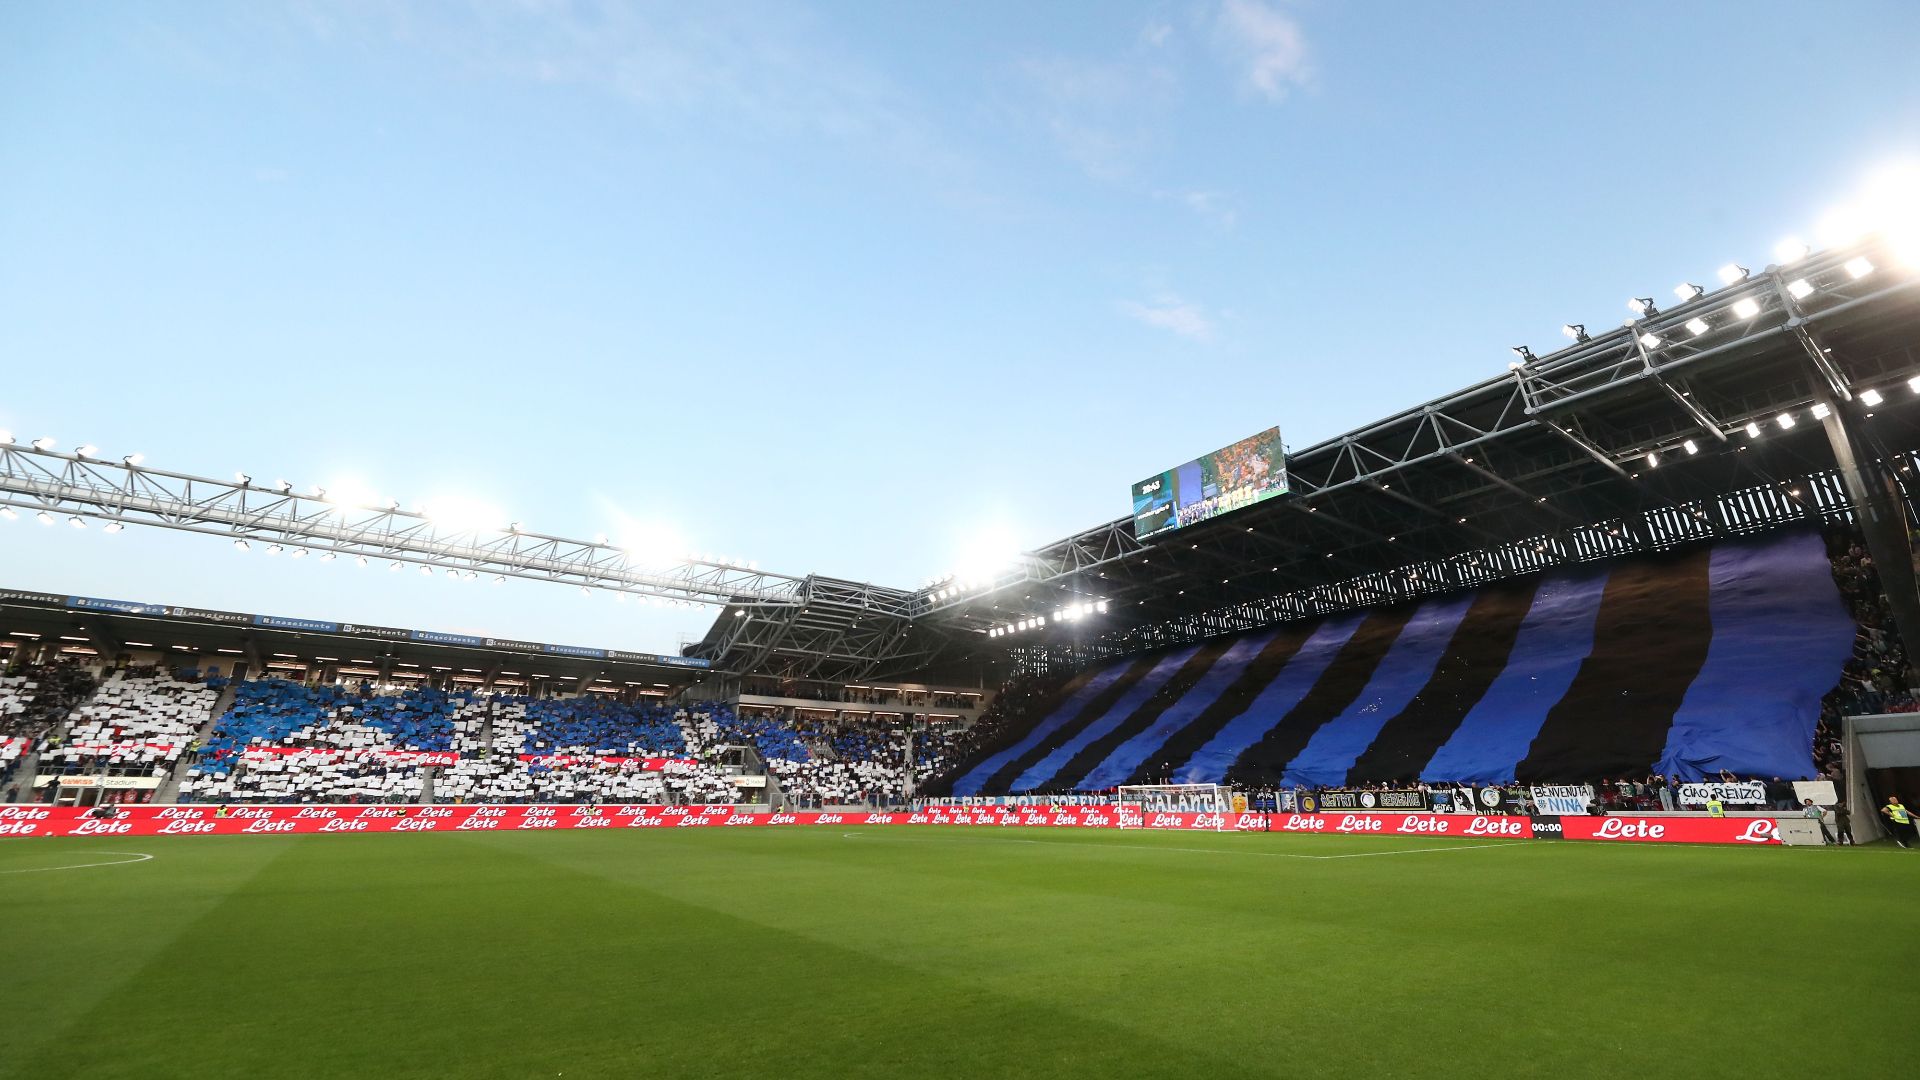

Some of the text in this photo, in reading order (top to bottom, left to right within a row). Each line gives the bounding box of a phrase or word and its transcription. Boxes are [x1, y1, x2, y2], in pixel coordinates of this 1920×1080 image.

[1683, 785, 1762, 800] CIAO RENZO
[521, 806, 556, 816] Lete
[616, 806, 647, 815] Lete
[660, 806, 689, 815] Lete
[700, 805, 728, 815] Lete
[1548, 797, 1584, 813] NINA
[152, 807, 204, 819] Lete
[227, 807, 274, 818] Lete
[292, 807, 337, 818] Lete
[356, 806, 398, 817] Lete
[415, 806, 453, 817] Lete
[470, 806, 506, 817] Lete
[391, 817, 437, 831] Lete
[456, 817, 498, 830] Lete
[518, 816, 557, 829] Lete
[574, 816, 611, 828] Lete
[628, 815, 663, 827] Lete
[677, 814, 710, 827] Lete
[724, 814, 755, 825] Lete
[767, 813, 796, 825] Lete
[815, 813, 843, 824] Lete
[864, 813, 893, 824] Lete
[907, 813, 929, 824] Lete
[932, 813, 951, 824] Lete
[954, 813, 972, 825] Lete
[976, 813, 995, 825] Lete
[1000, 813, 1020, 824] Lete
[1025, 813, 1048, 825] Lete
[1053, 813, 1077, 825] Lete
[1083, 813, 1109, 826] Lete
[1116, 813, 1143, 828] Lete
[1152, 813, 1182, 828] Lete
[1191, 814, 1225, 829] Lete
[1283, 814, 1325, 831] Lete
[1336, 815, 1382, 832] Lete
[1397, 816, 1449, 833] Lete
[0, 820, 37, 834] ete
[68, 819, 132, 835] Lete
[157, 819, 216, 834] Lete
[242, 818, 296, 832] Lete
[318, 818, 369, 832] Lete
[1464, 816, 1522, 835] Lete
[1532, 823, 1562, 832] 00:00
[1592, 818, 1665, 839] Lete
